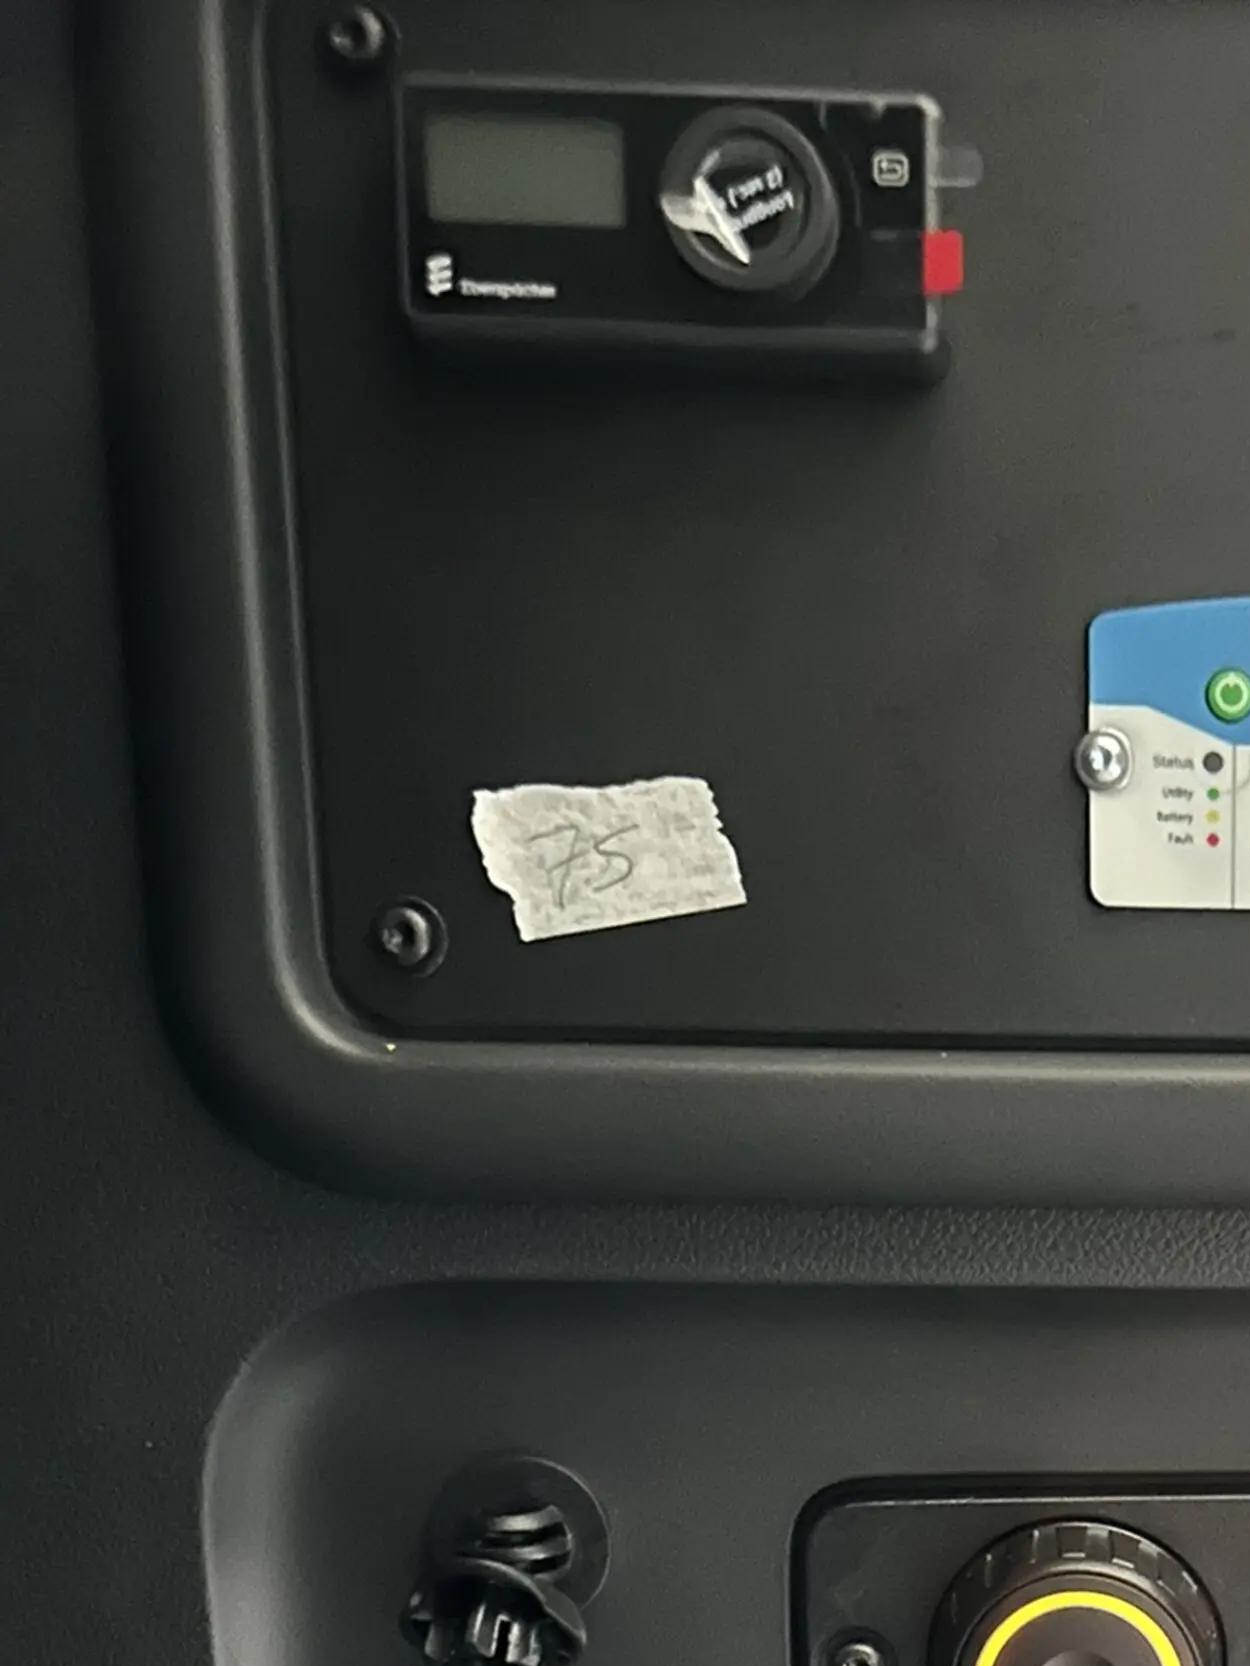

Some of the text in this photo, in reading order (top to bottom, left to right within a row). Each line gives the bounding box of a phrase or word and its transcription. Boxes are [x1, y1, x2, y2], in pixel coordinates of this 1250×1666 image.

[1153, 756, 1194, 770] Status
[1156, 810, 1194, 824] Battery
[1168, 833, 1194, 844] Fault
